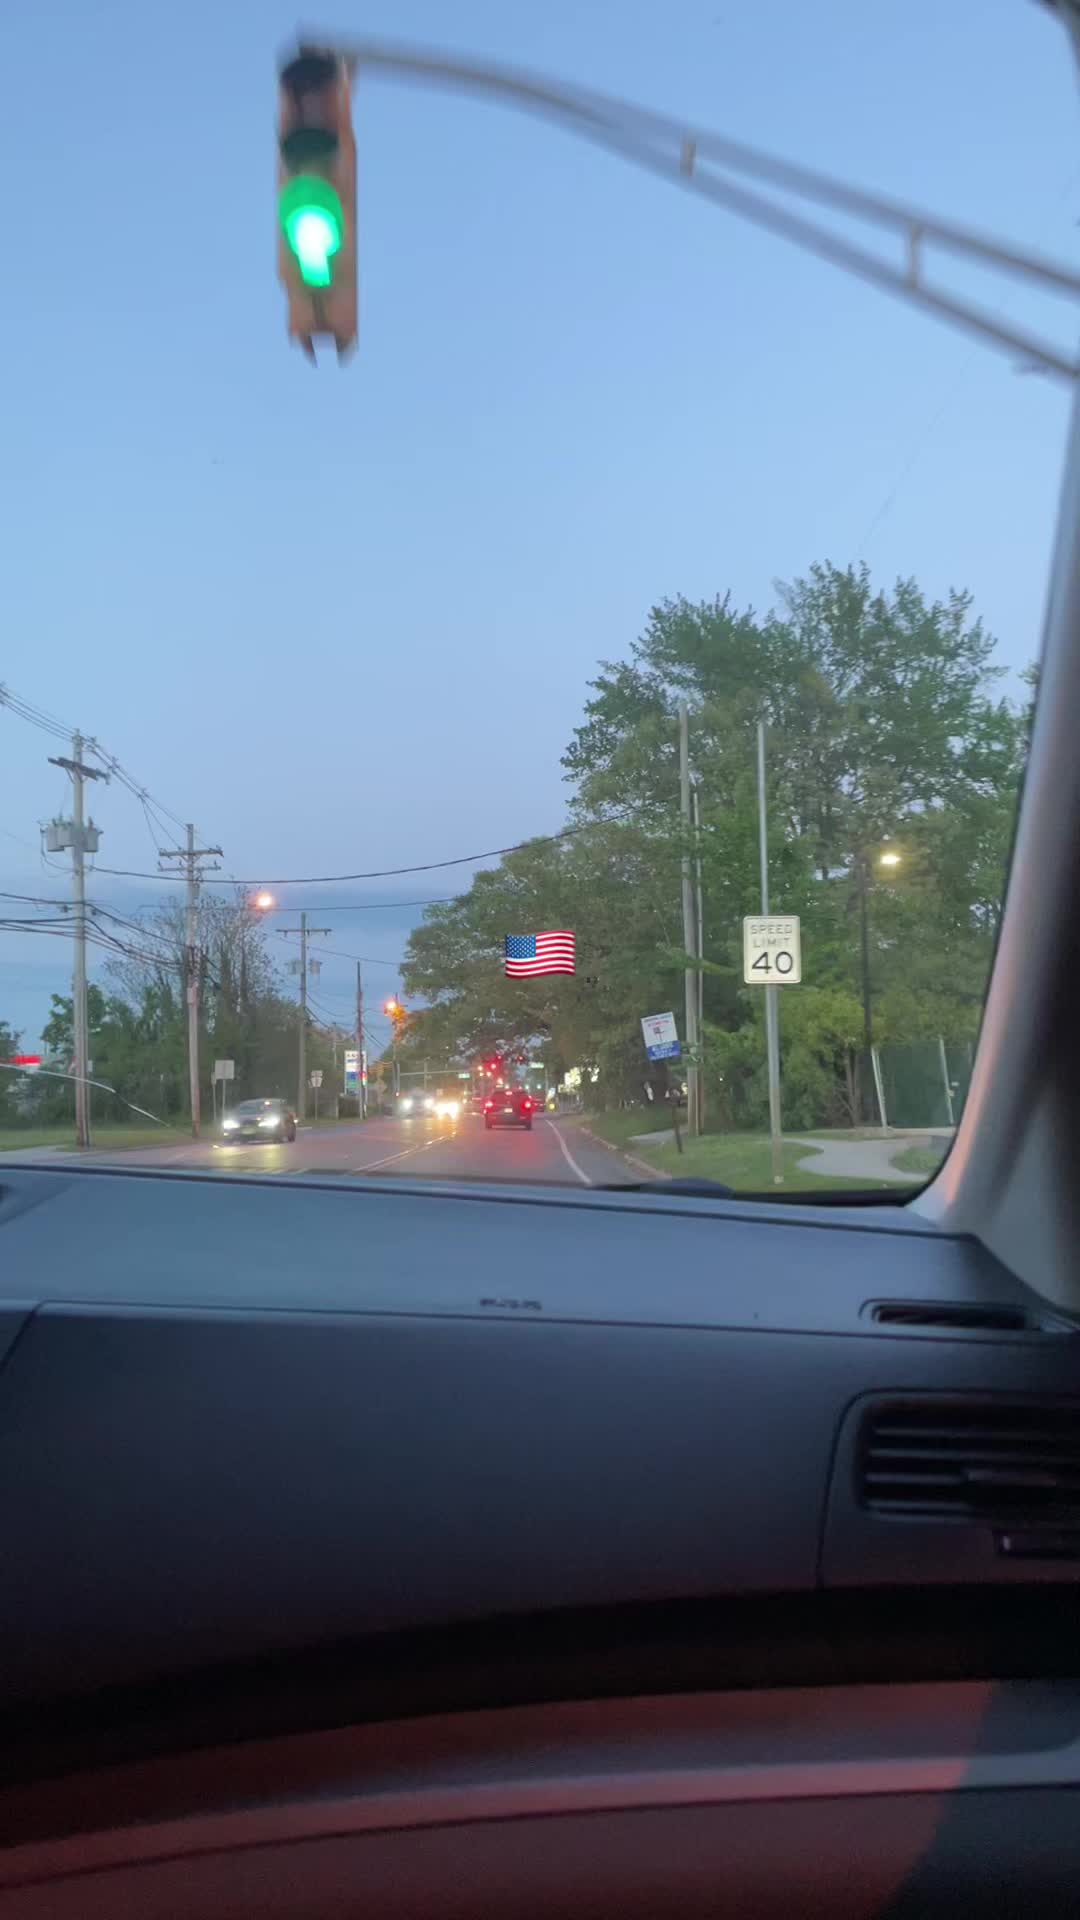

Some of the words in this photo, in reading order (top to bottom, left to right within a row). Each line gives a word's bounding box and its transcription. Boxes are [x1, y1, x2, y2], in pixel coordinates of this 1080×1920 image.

[751, 924, 793, 935] SPEED
[753, 937, 791, 948] LIMIT
[751, 951, 793, 974] 40
